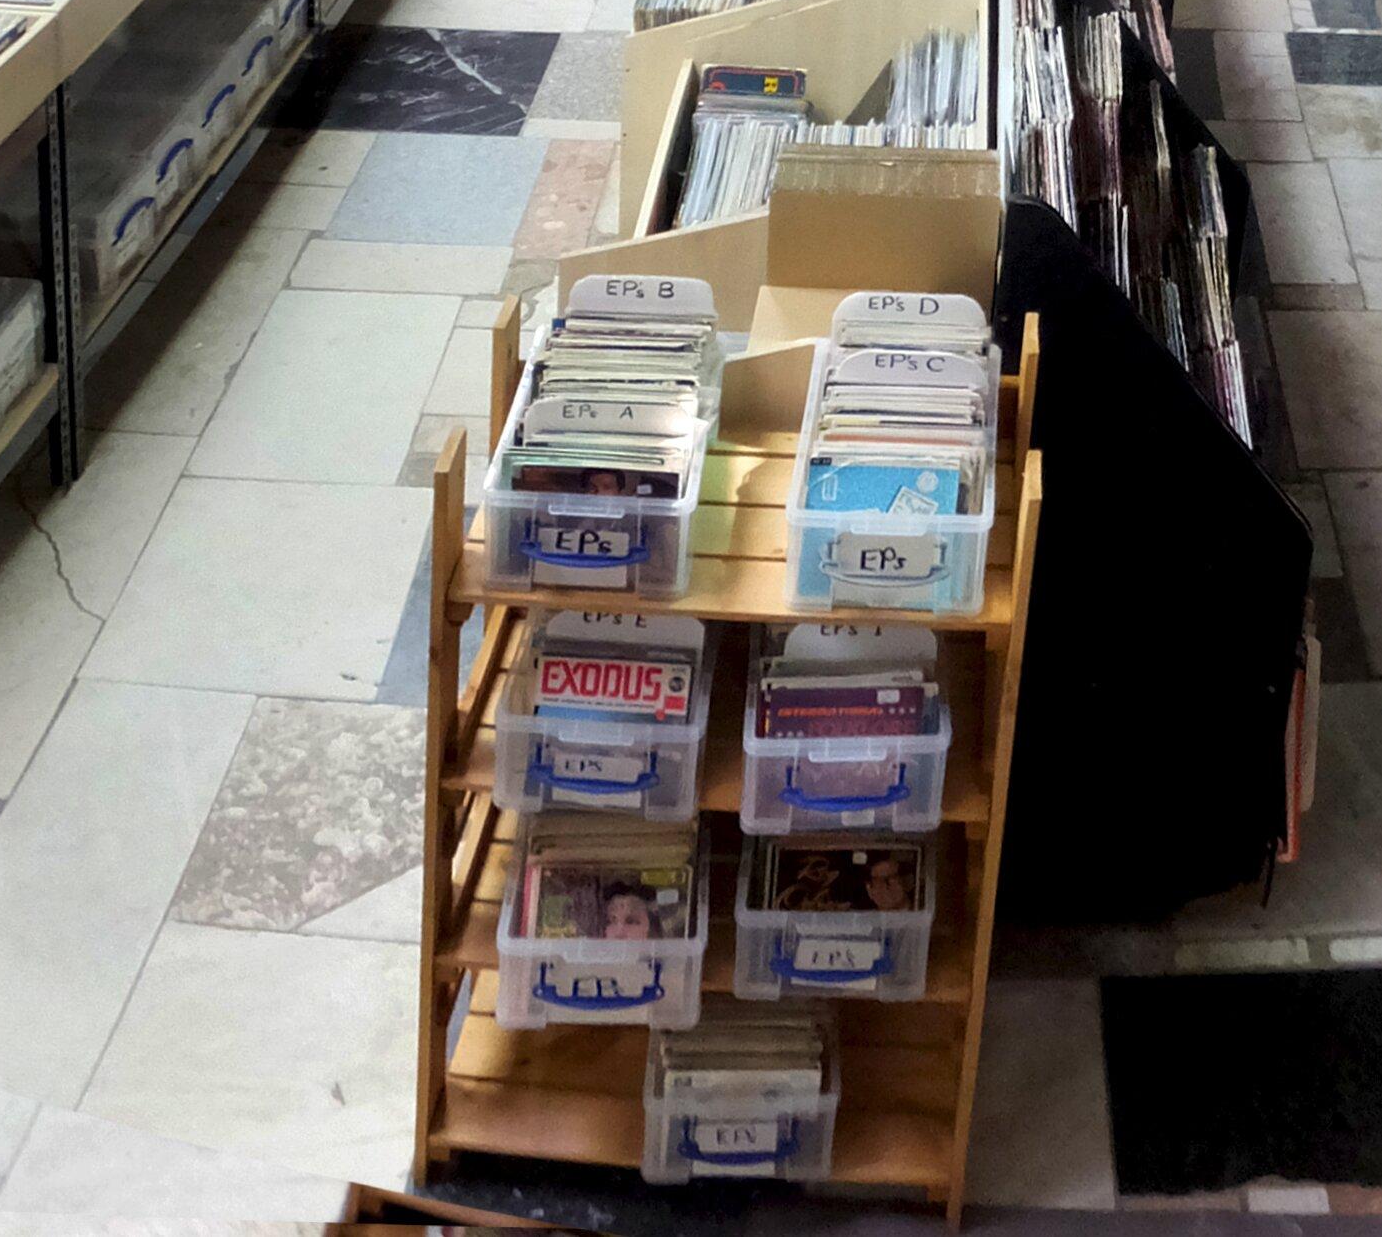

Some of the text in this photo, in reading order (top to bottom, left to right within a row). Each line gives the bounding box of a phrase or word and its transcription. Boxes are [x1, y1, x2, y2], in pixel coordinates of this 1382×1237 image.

[658, 281, 675, 299] B
[868, 296, 939, 315] EP's D
[874, 353, 946, 372] EP's C
[619, 406, 634, 419] A
[555, 530, 613, 553] EPs
[860, 549, 907, 571] EPs
[541, 660, 662, 701] EXODUS
